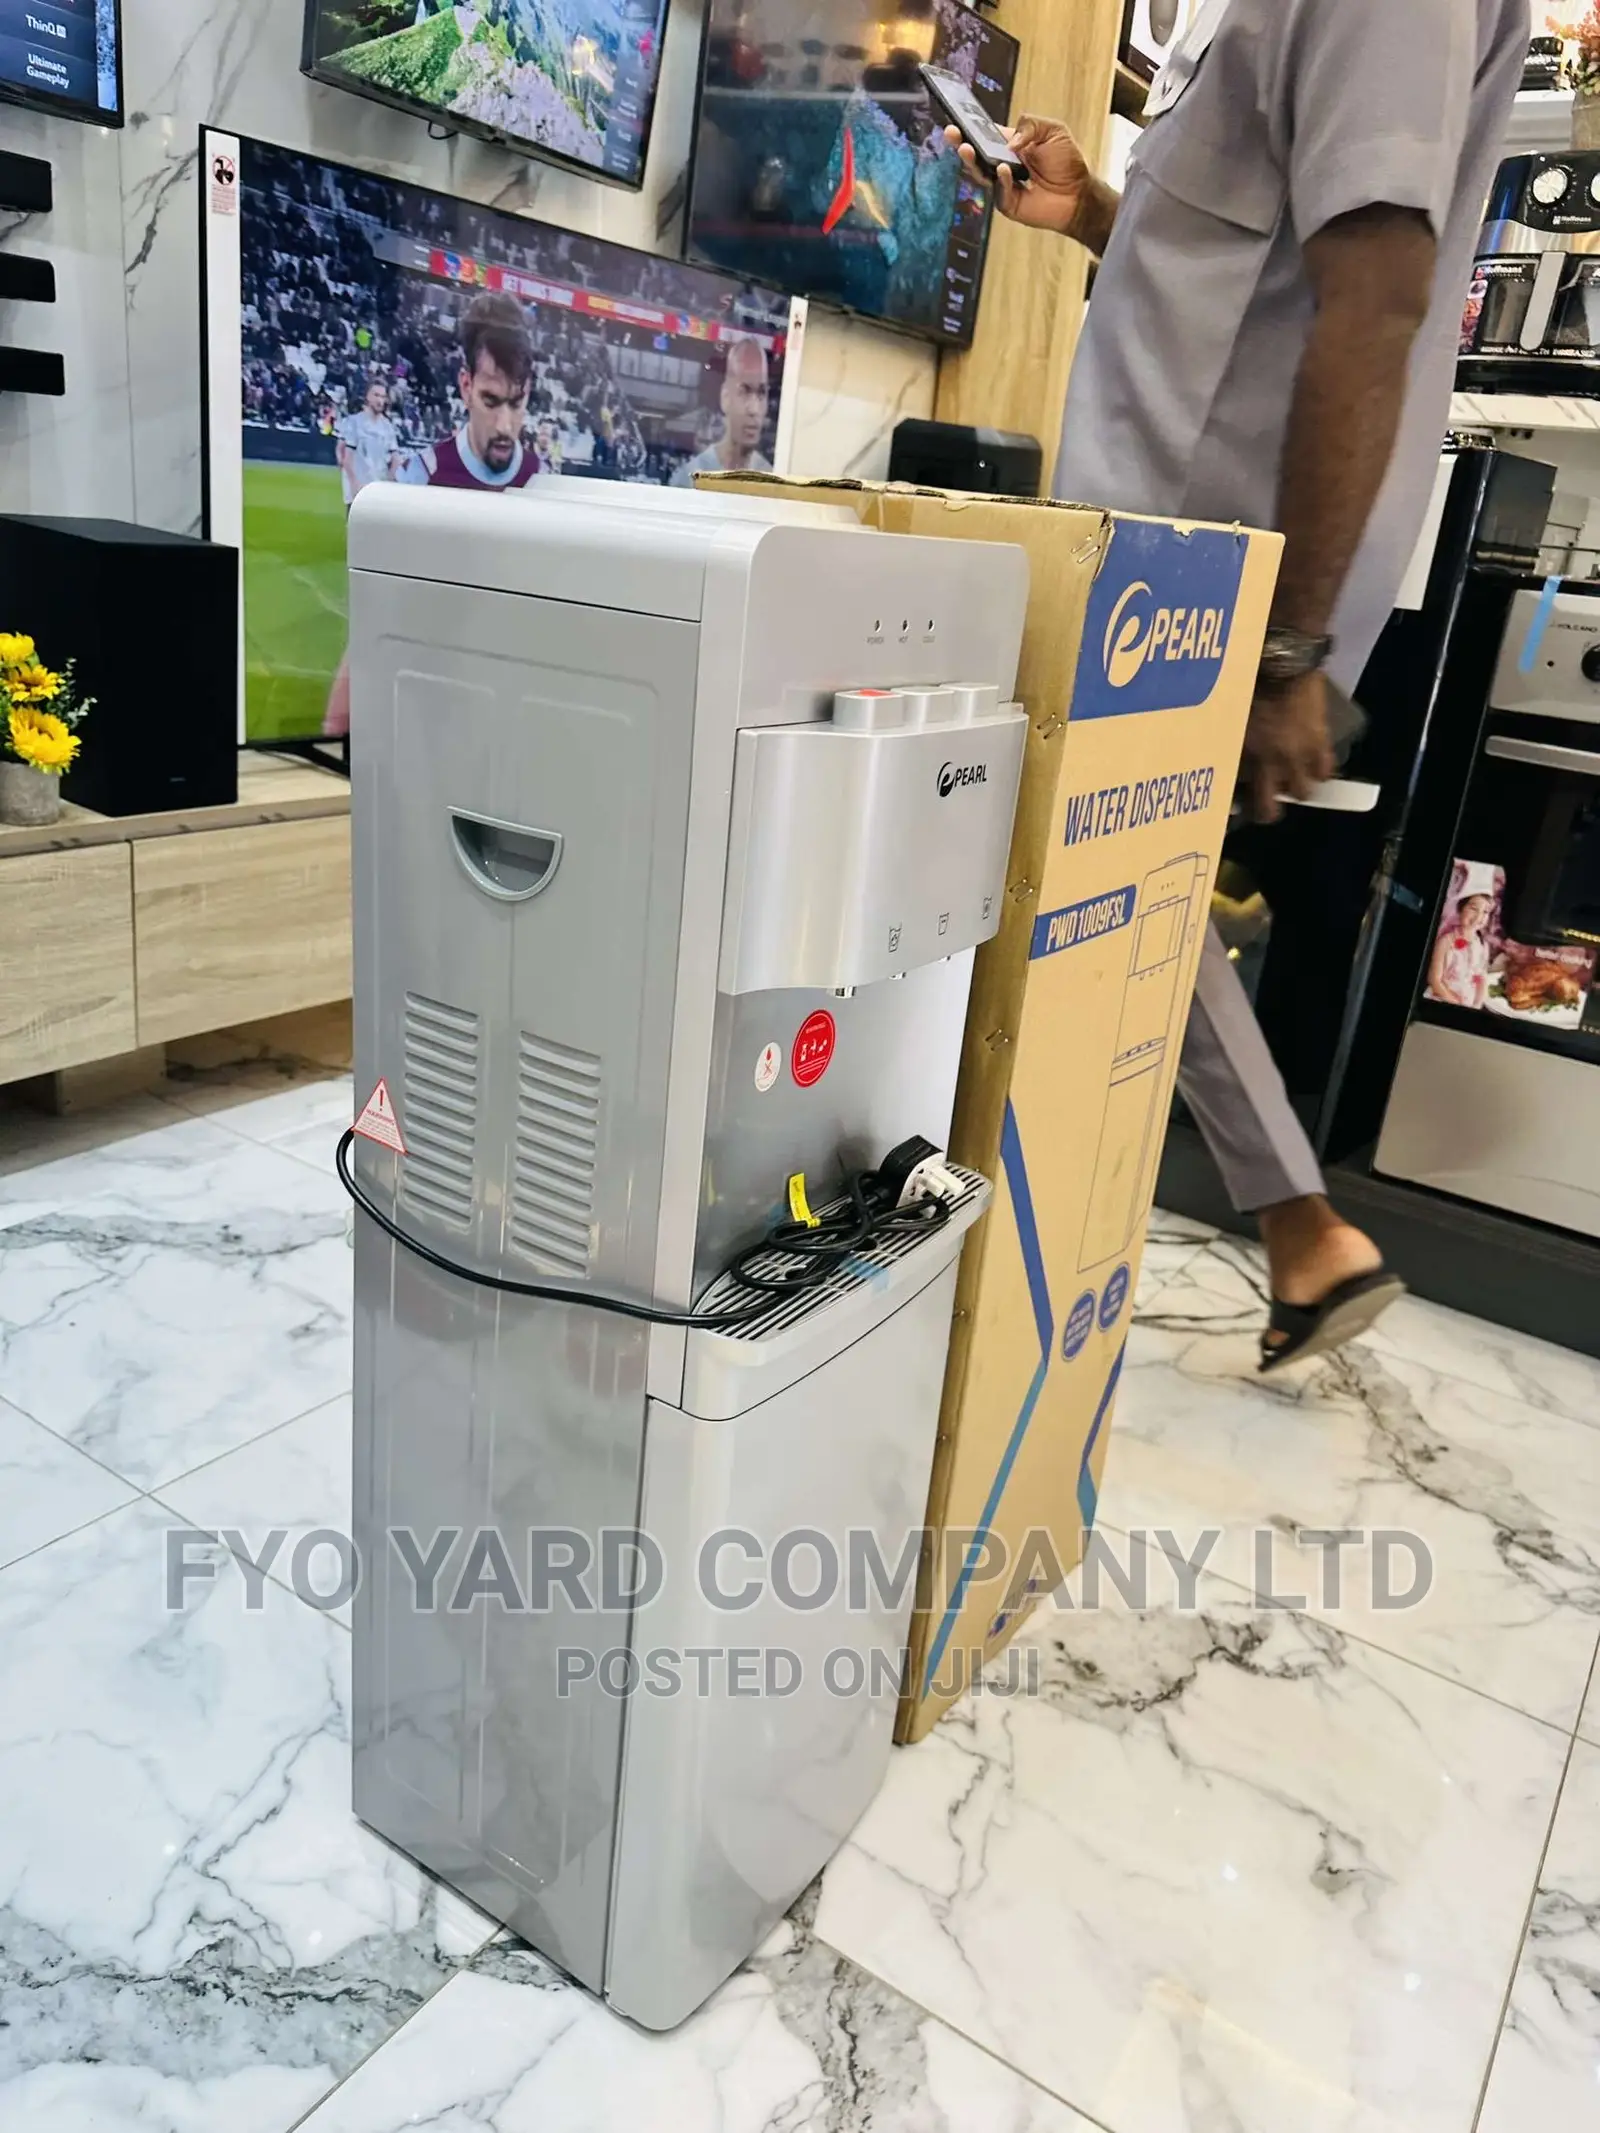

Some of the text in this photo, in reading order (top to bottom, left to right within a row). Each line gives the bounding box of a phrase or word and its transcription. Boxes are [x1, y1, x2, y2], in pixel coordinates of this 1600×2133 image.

[25, 14, 57, 36] ThinQ
[27, 53, 67, 74] Ultimate
[26, 65, 70, 89] Gameplay
[1147, 607, 1224, 662] PEARL
[954, 763, 987, 788] PEARL
[1064, 766, 1215, 847] WATER DISPENSER
